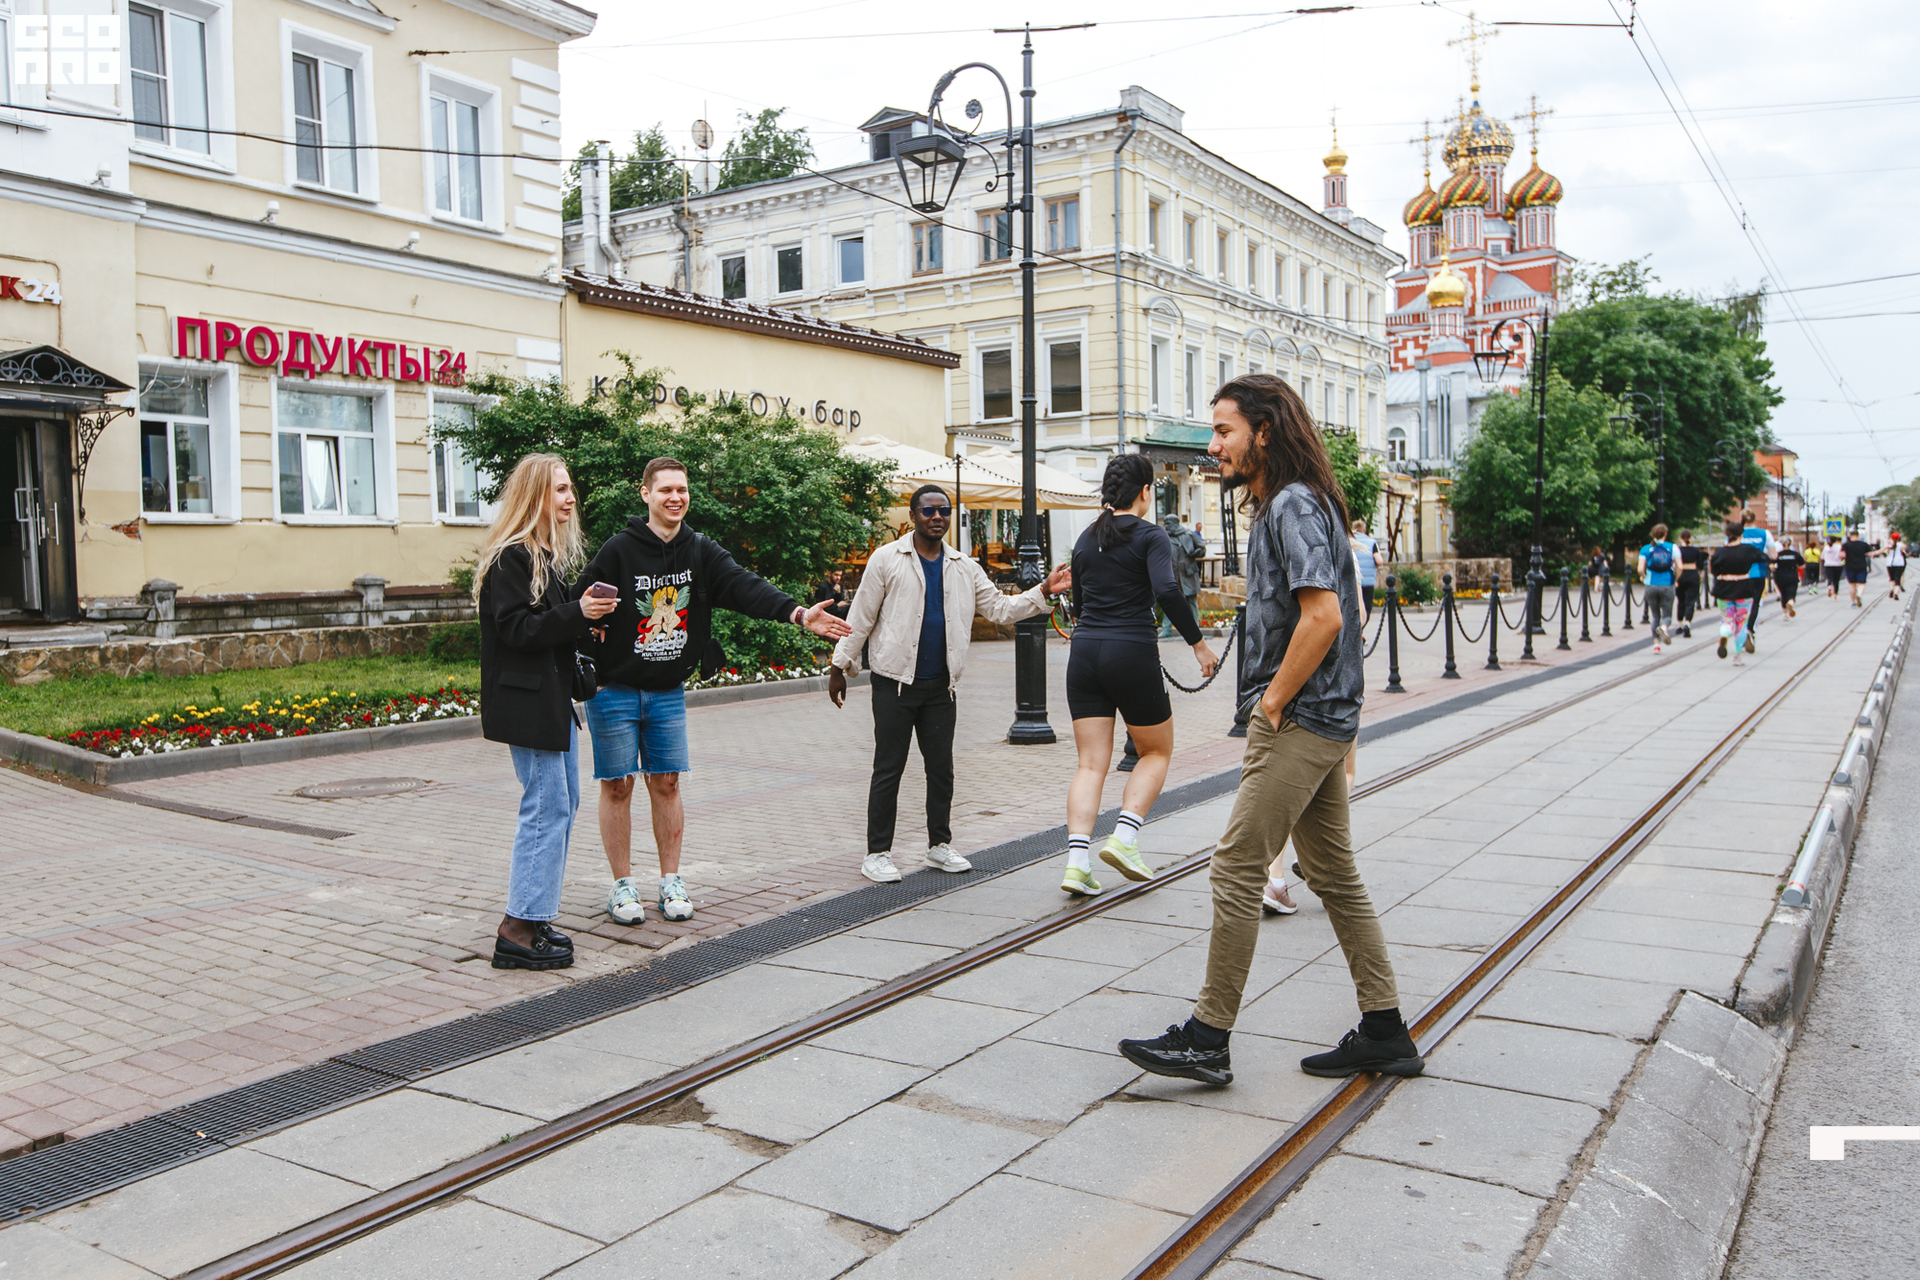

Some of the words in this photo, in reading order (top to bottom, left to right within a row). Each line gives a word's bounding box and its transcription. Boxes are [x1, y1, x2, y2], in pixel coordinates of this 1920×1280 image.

[172, 316, 431, 382] ПРОДУКТЫ
[436, 349, 467, 374] 24
[811, 399, 861, 433] бар
